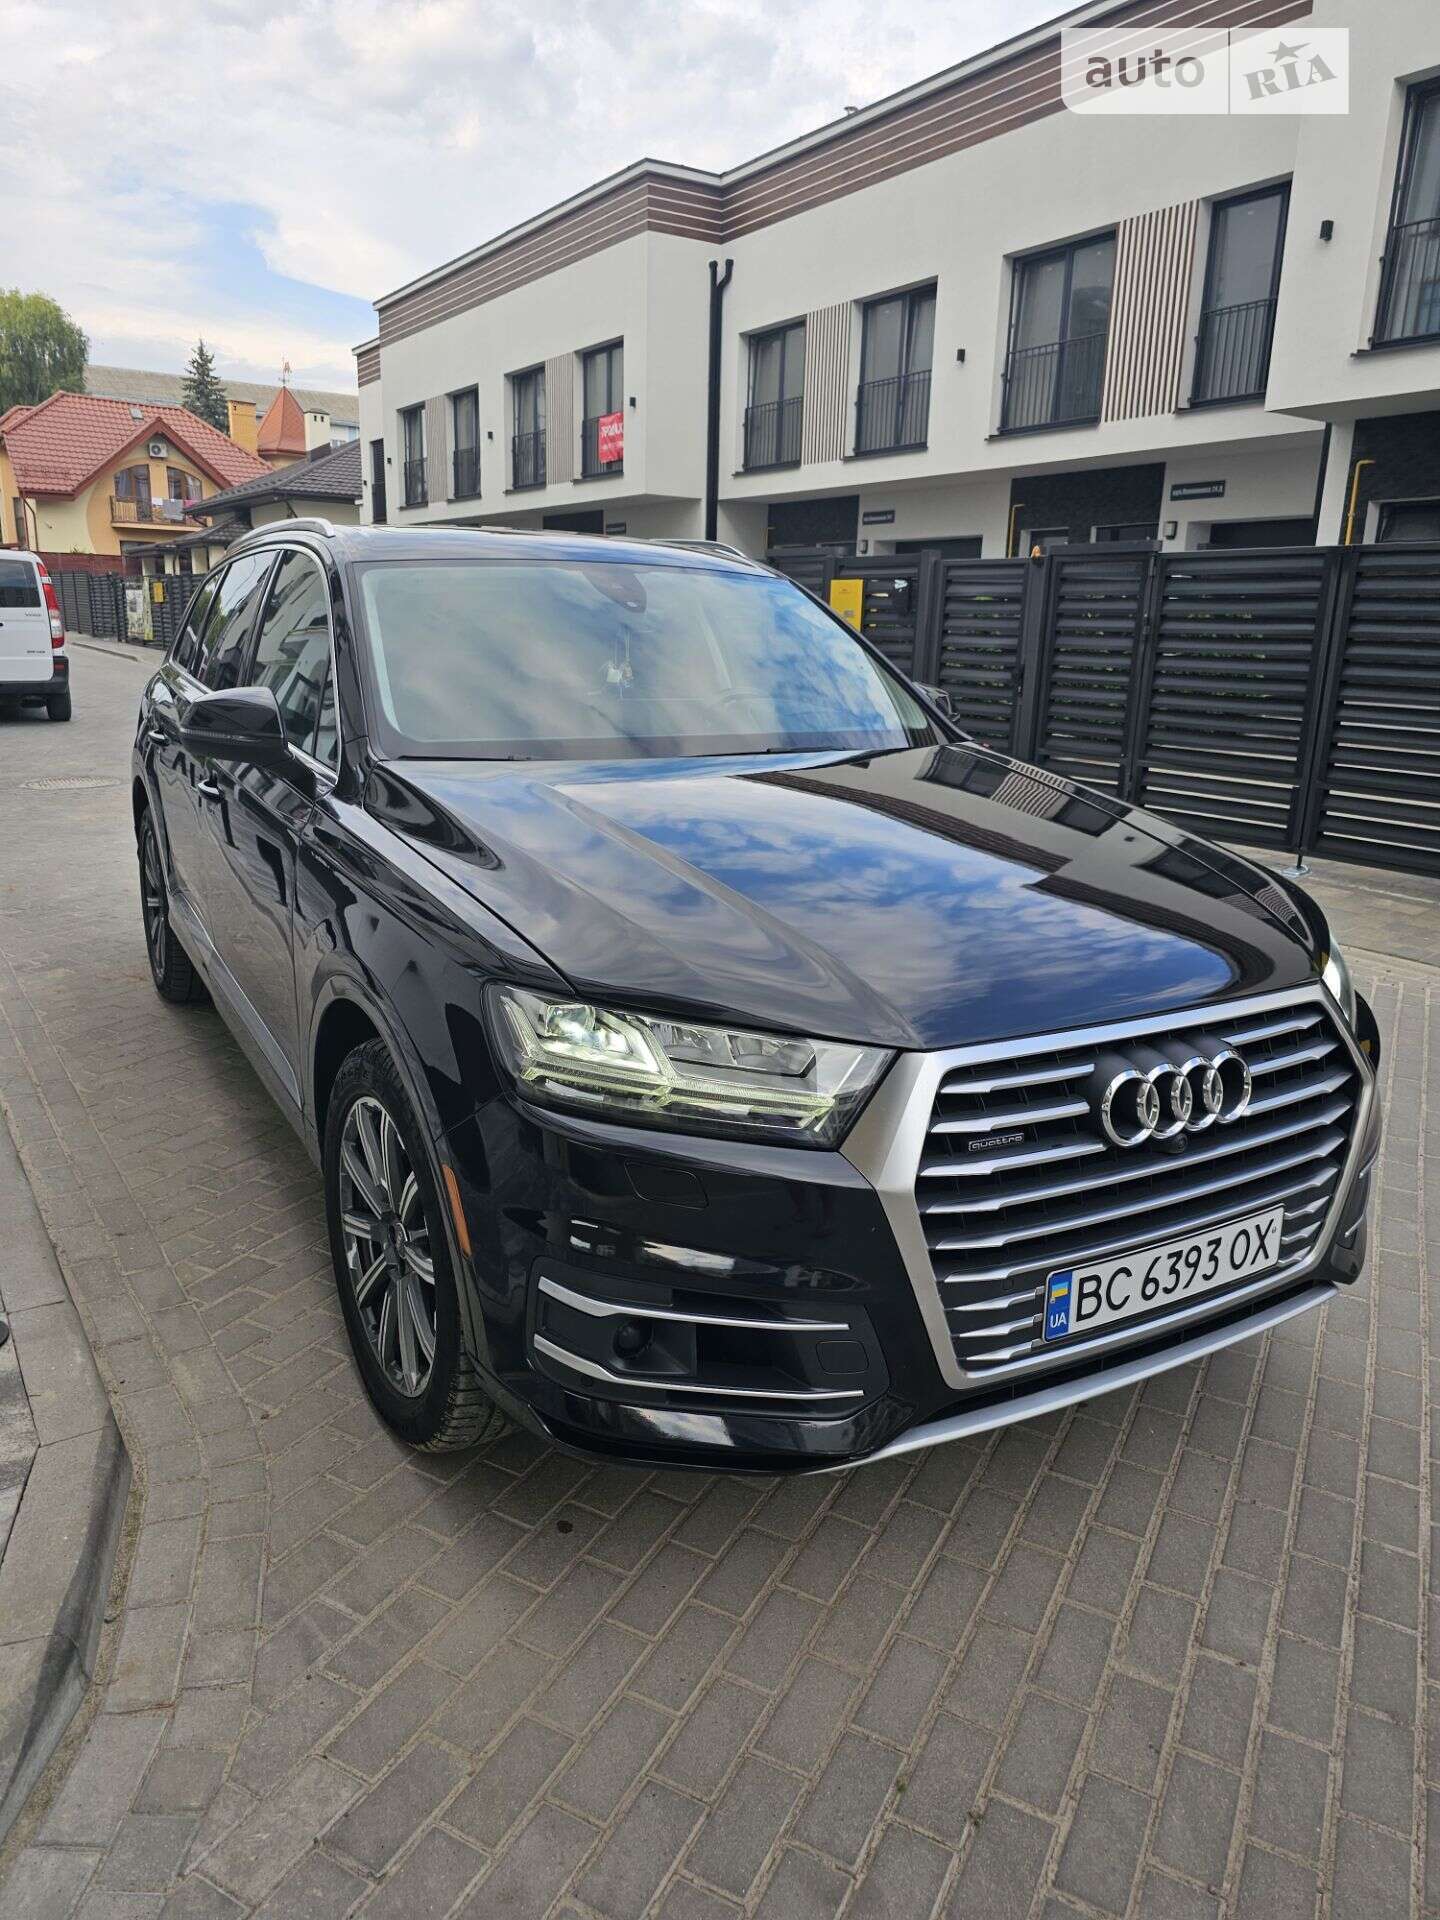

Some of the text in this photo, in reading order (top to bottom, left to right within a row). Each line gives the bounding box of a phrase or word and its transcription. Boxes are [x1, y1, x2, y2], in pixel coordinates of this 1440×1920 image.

[971, 1135, 1023, 1150] quattro
[1075, 1218, 1275, 1323] BC 6393 OX
[1049, 1311, 1067, 1329] UA
